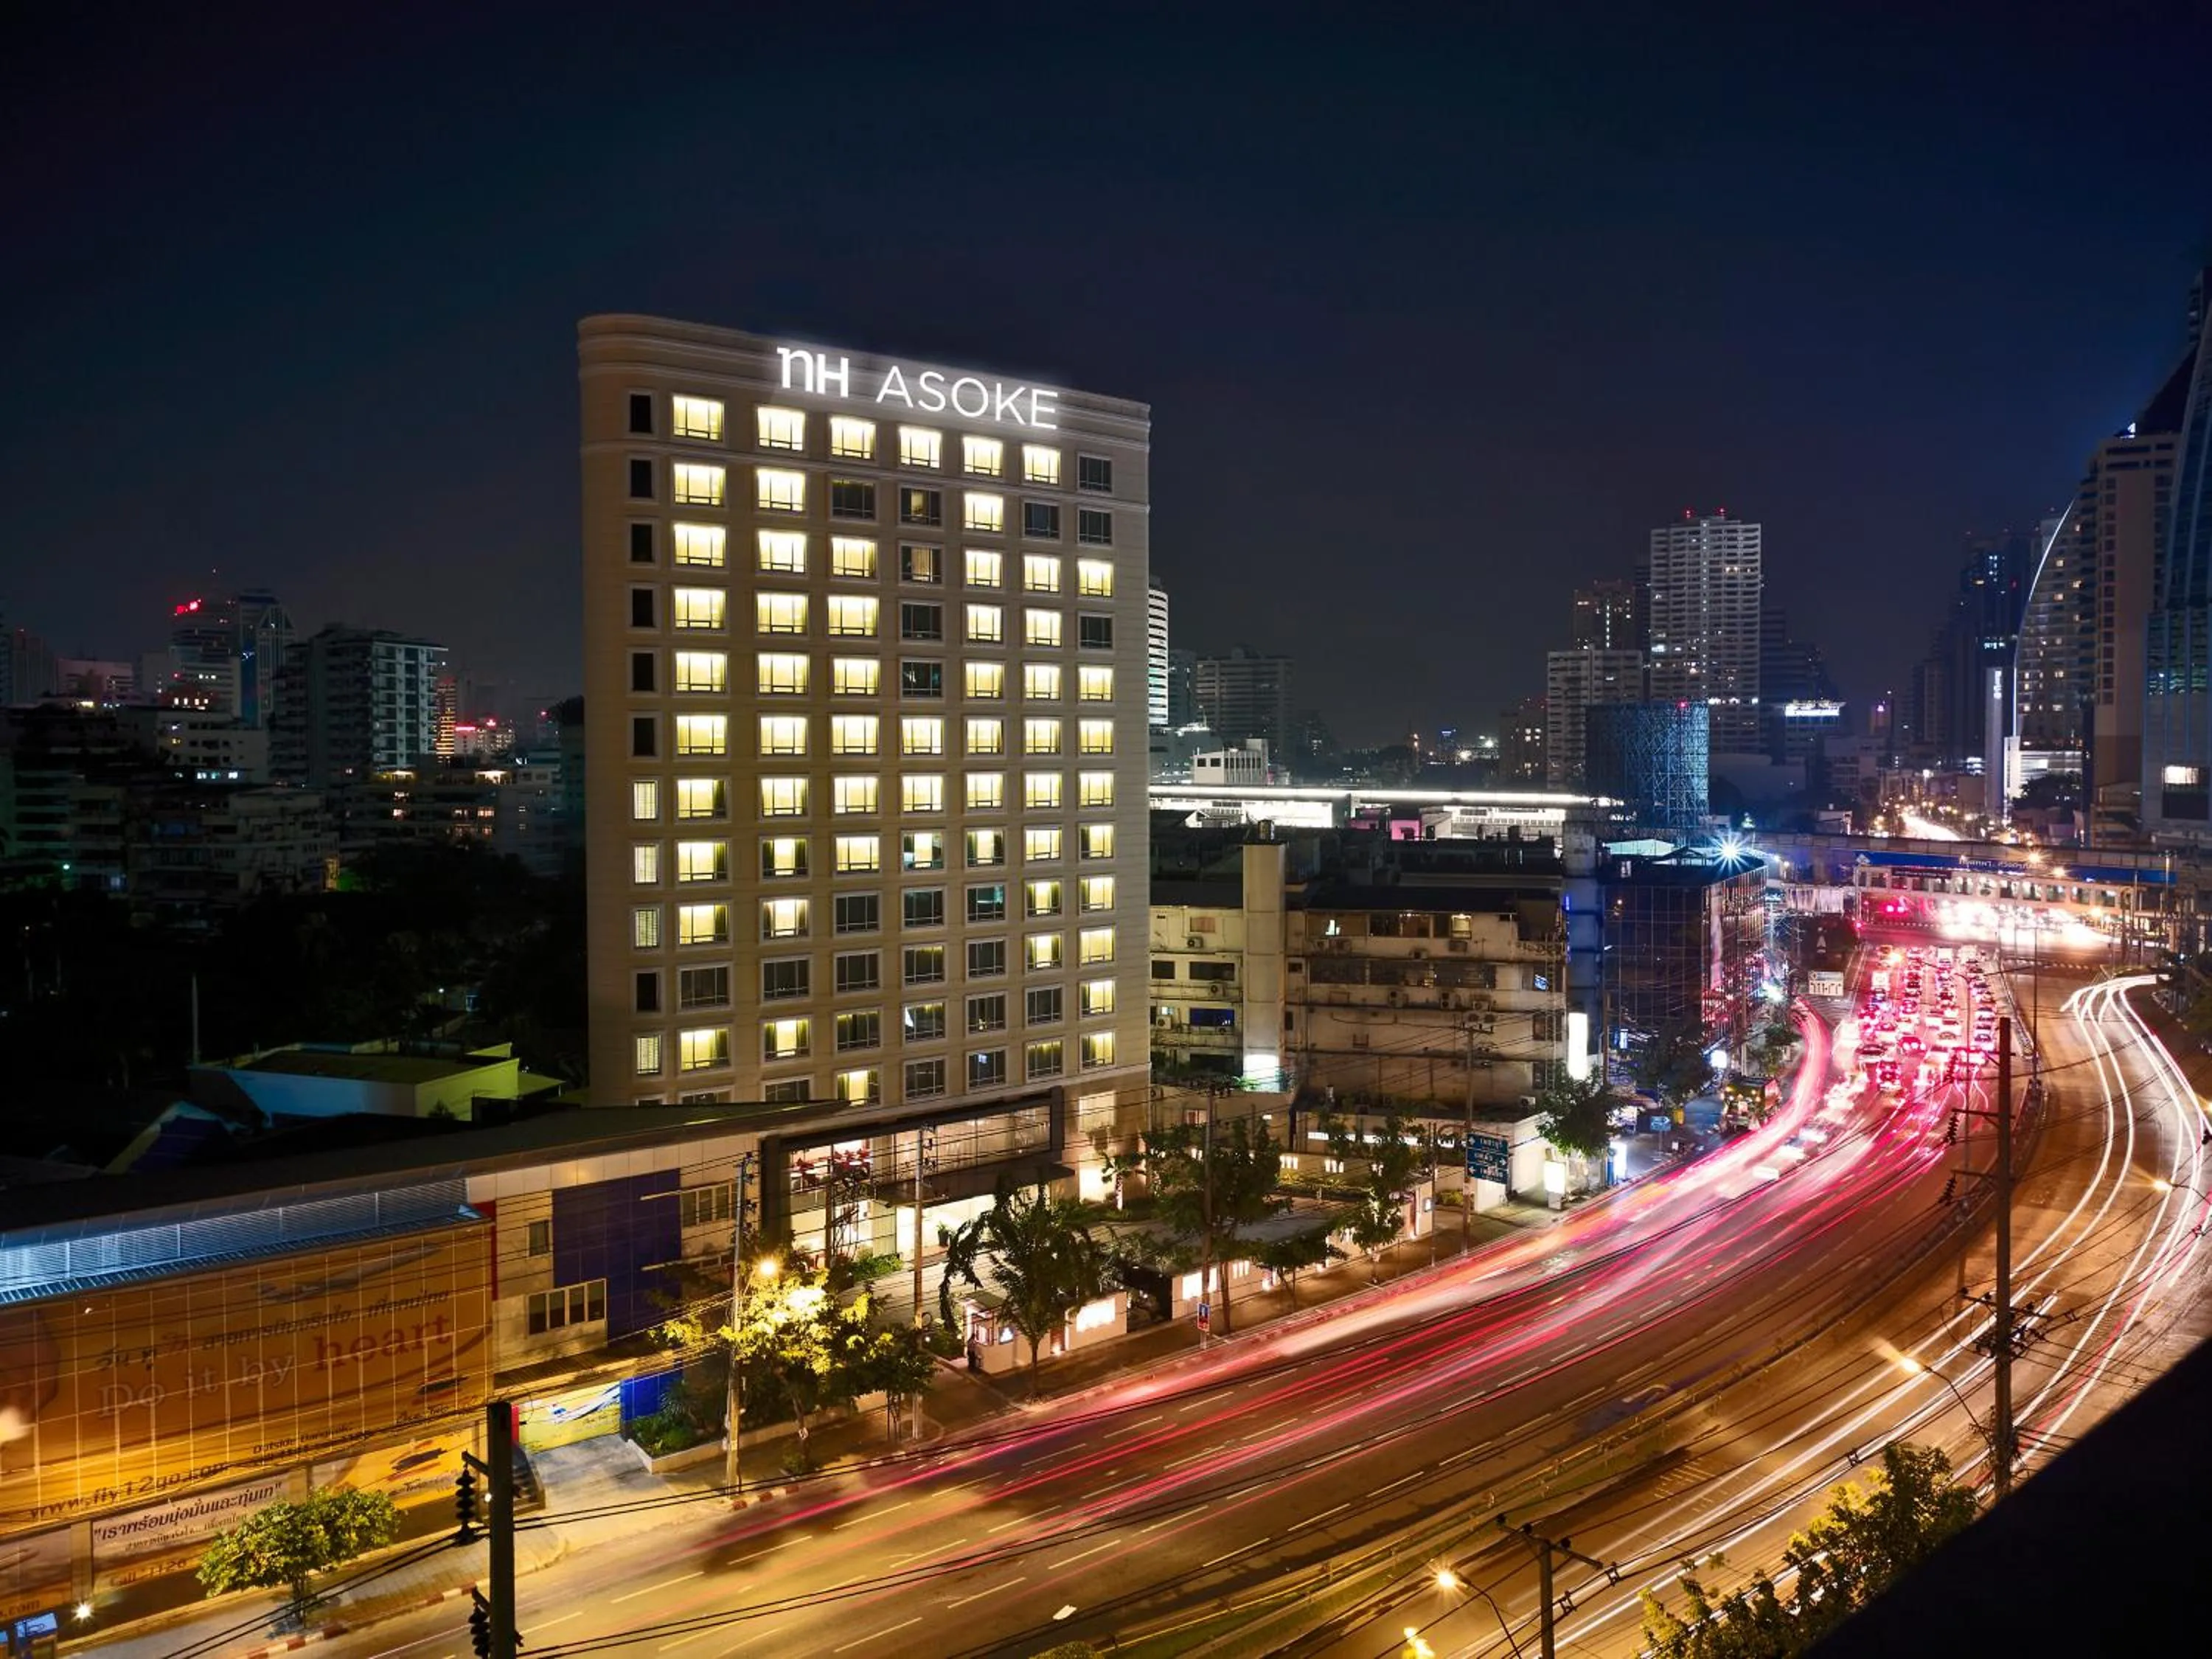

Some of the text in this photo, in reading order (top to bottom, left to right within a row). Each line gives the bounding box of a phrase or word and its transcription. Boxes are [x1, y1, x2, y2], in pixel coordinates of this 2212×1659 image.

[875, 365, 1059, 430] ASOKE
[98, 1313, 451, 1417] Do it by heart
